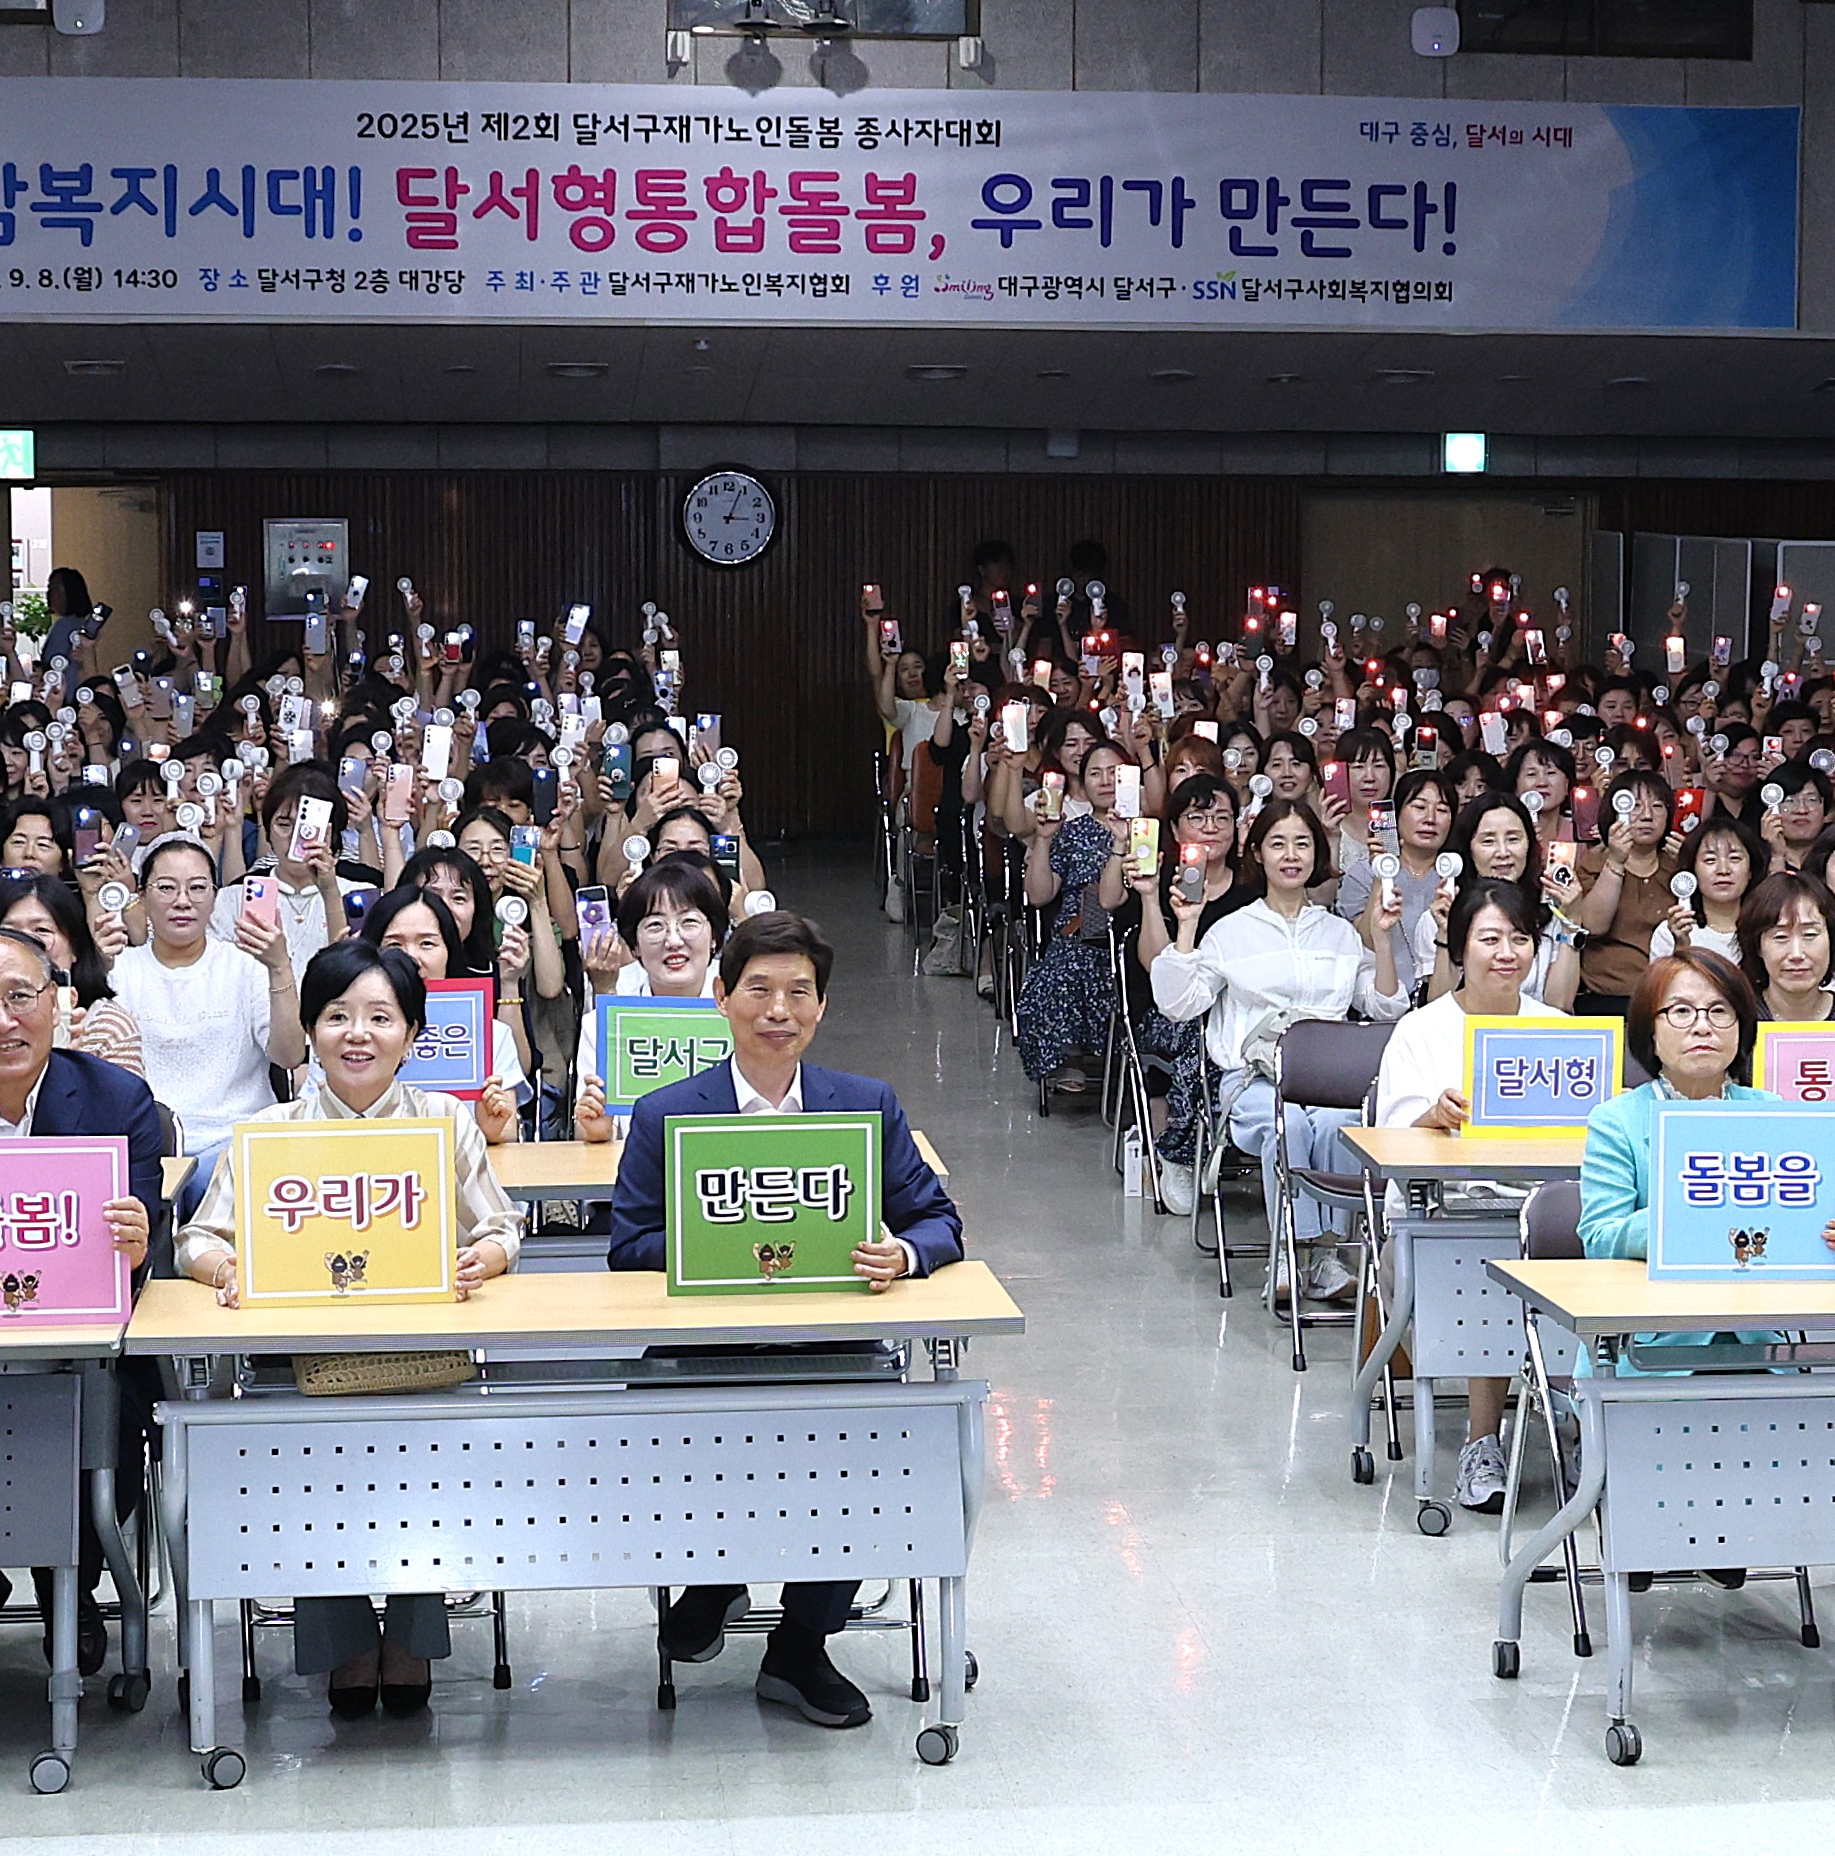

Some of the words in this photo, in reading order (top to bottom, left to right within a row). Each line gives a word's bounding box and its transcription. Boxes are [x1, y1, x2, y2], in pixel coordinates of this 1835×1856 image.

[356, 112, 469, 143] 2025년
[481, 112, 560, 142] 제2회
[572, 112, 844, 148] 달서구재가노인돌봄
[854, 116, 1002, 149] 종사자대회
[1360, 121, 1401, 144] 대구
[1410, 121, 1458, 149] 중심,
[1466, 123, 1524, 149] 달서의
[1532, 125, 1574, 149] 시대
[396, 164, 946, 261] 달서형통합돌봄,
[970, 173, 1196, 249] 우리가
[1219, 176, 1457, 258] 만든다!
[113, 268, 178, 290] 14:30
[257, 267, 346, 293] 달서구청
[354, 268, 390, 293] 2층
[398, 269, 465, 293] 대강당
[608, 270, 851, 296] 달서구재가노인복지협회
[998, 274, 1105, 299] 대구광역시
[1193, 280, 1237, 300] SSN
[1242, 277, 1453, 304] 달서구사회복지협의회
[709, 485, 718, 495] 11
[723, 481, 735, 492] 12
[742, 485, 747, 495] 1
[697, 497, 707, 508] 10
[752, 497, 762, 508] 2
[693, 512, 702, 523] 9
[756, 513, 765, 523] 3
[698, 529, 706, 539] 8
[751, 528, 759, 539] 4
[709, 541, 718, 551] 7
[725, 543, 734, 555] 6
[741, 540, 750, 551] 5
[407, 1024, 472, 1060] 좋은
[1493, 1055, 1598, 1100] 달서형
[1679, 1150, 1821, 1207] 돌봄을
[694, 1164, 852, 1224] 만든다
[263, 1171, 426, 1233] 우리가
